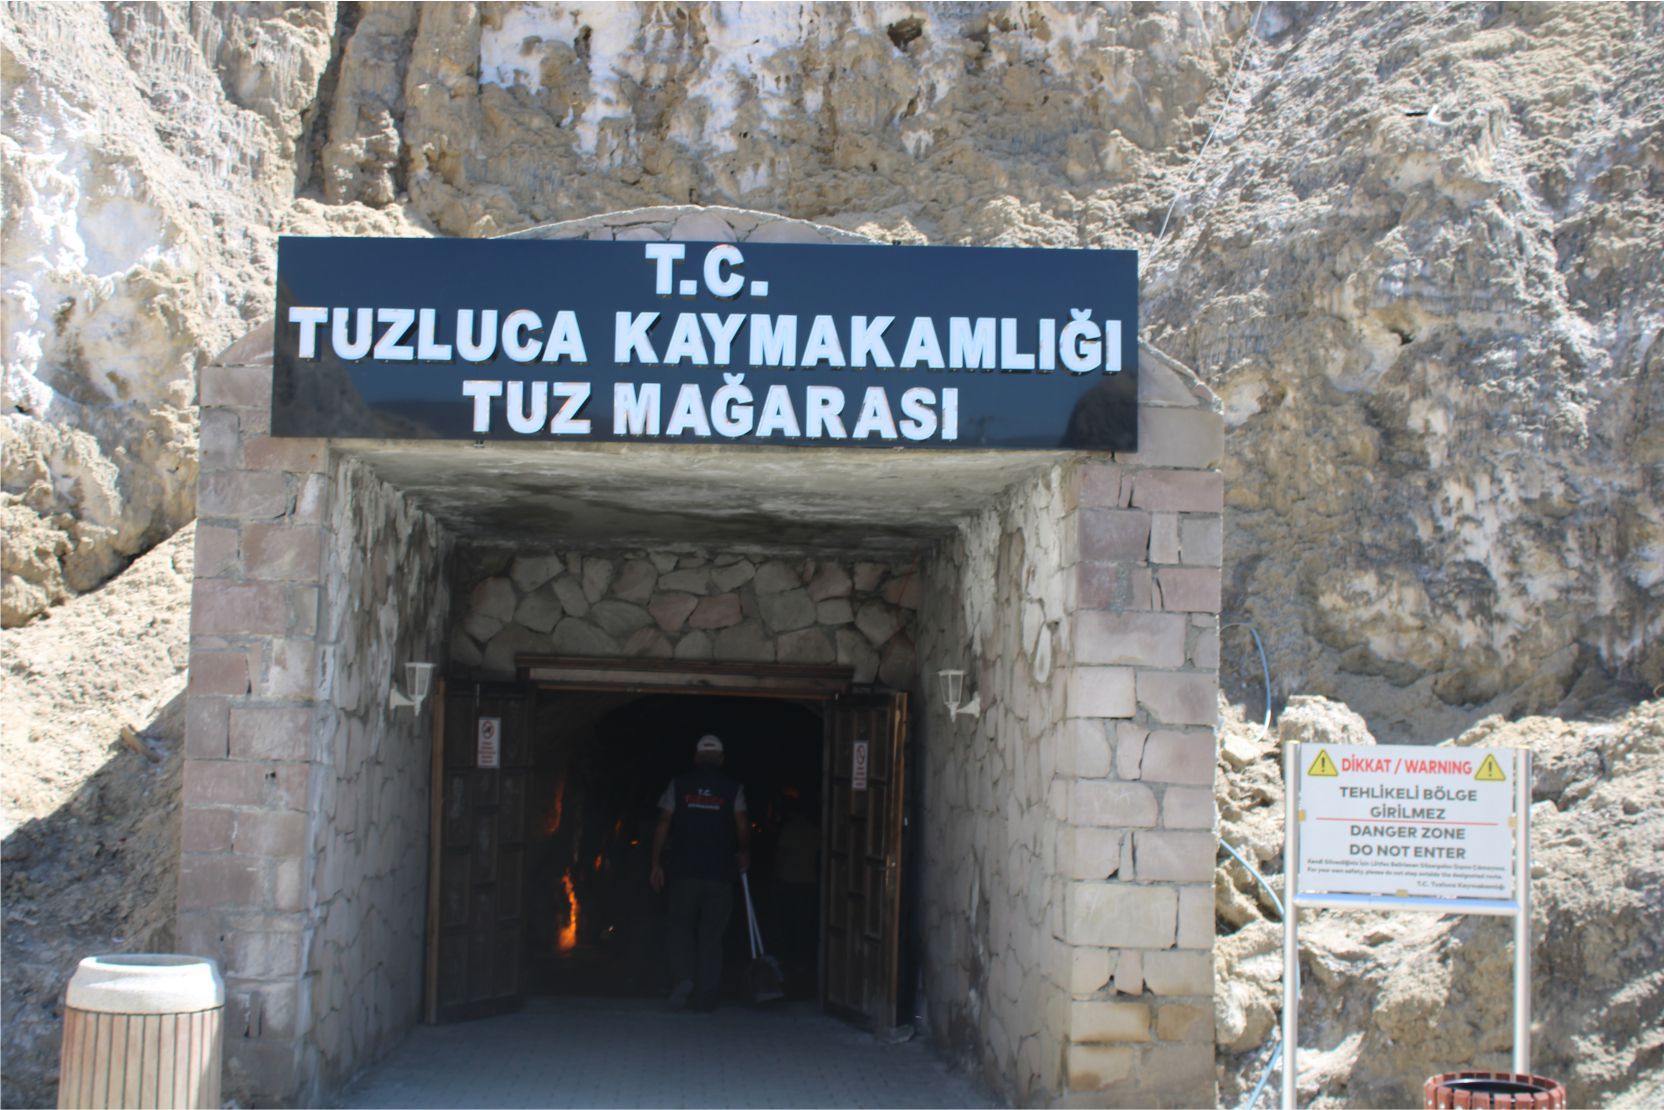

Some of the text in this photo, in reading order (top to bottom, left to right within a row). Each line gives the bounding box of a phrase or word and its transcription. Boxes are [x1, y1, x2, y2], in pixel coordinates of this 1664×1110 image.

[645, 243, 769, 298] T.C.
[288, 306, 1122, 373] TUZLUCA KAYMAKAMLIĞI
[462, 372, 959, 441] TUZ MAĞARASI
[1341, 754, 1472, 775] DİKKAT / WARNING
[1339, 784, 1477, 802] TEHLİKELİ BÖLGE
[1370, 804, 1446, 820] GİRİLMEZ
[1350, 824, 1465, 840] DANGER ZONE
[1349, 844, 1466, 859] DO NOT ENTER
